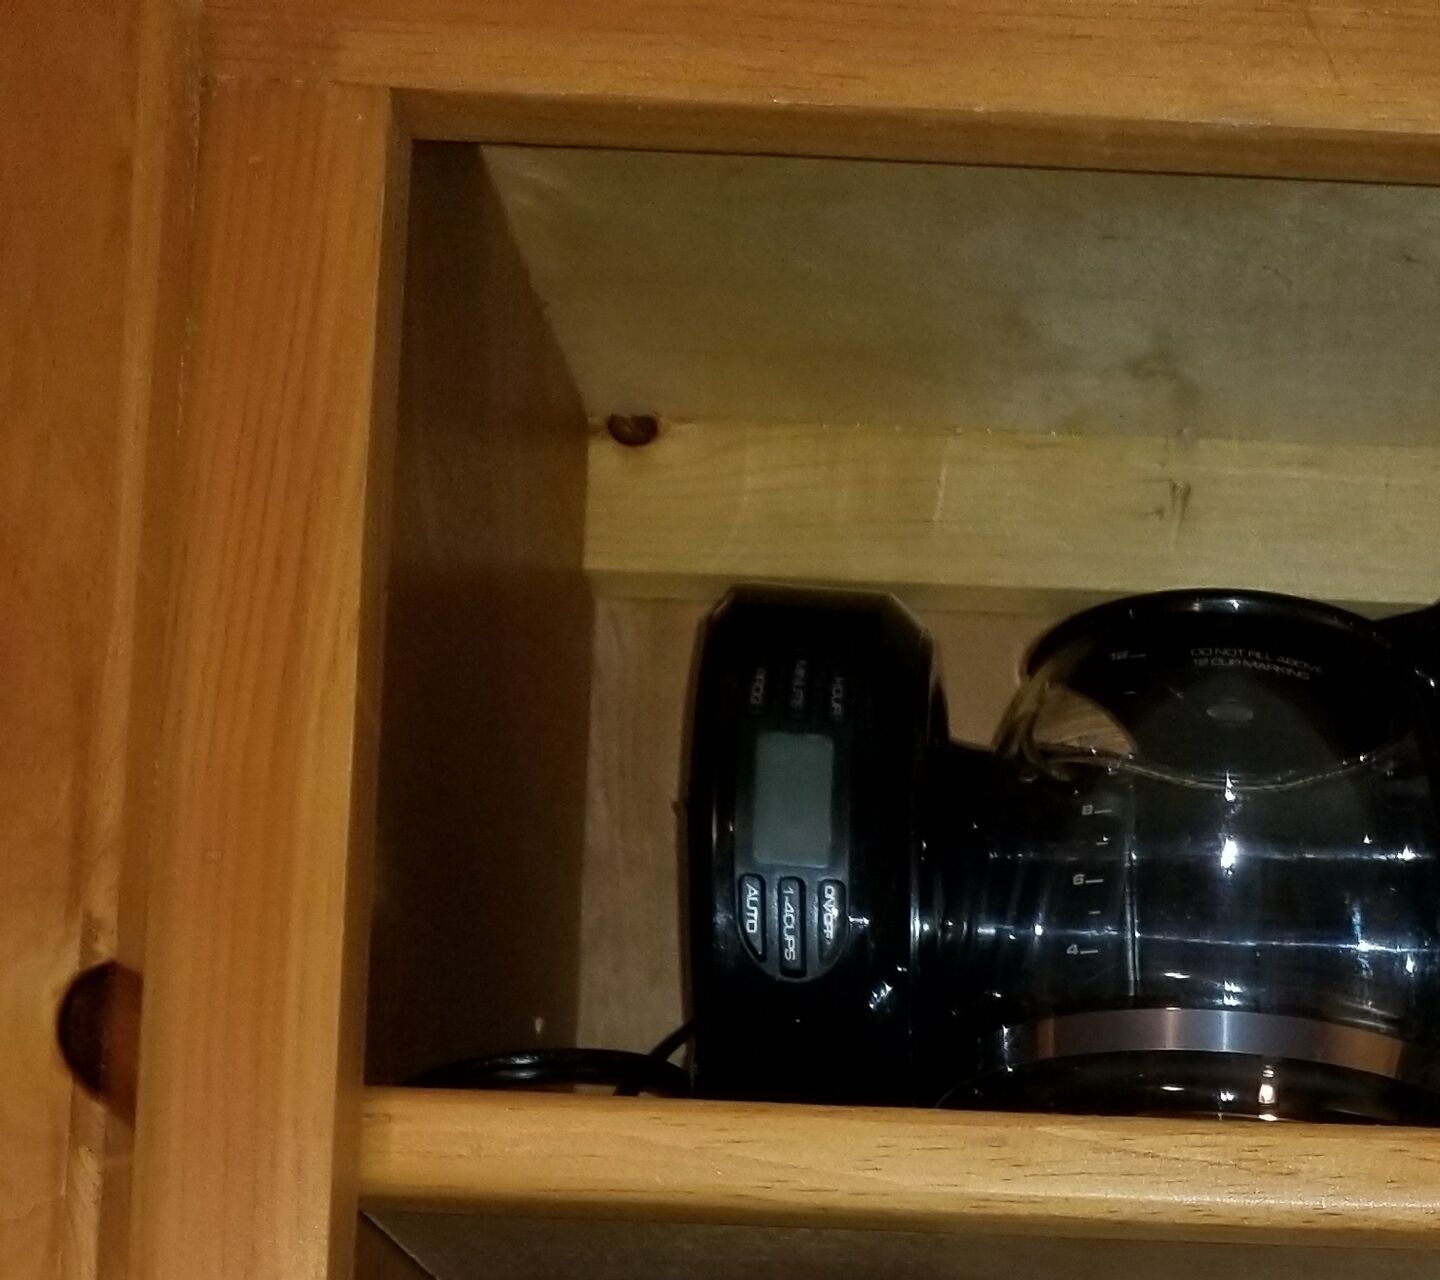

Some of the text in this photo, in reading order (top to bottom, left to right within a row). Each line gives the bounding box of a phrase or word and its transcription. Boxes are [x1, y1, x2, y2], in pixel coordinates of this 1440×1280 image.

[1073, 874, 1085, 885] 6
[746, 883, 759, 934] AUTO
[823, 885, 837, 940] ON/OFF
[1066, 944, 1079, 954] 4
